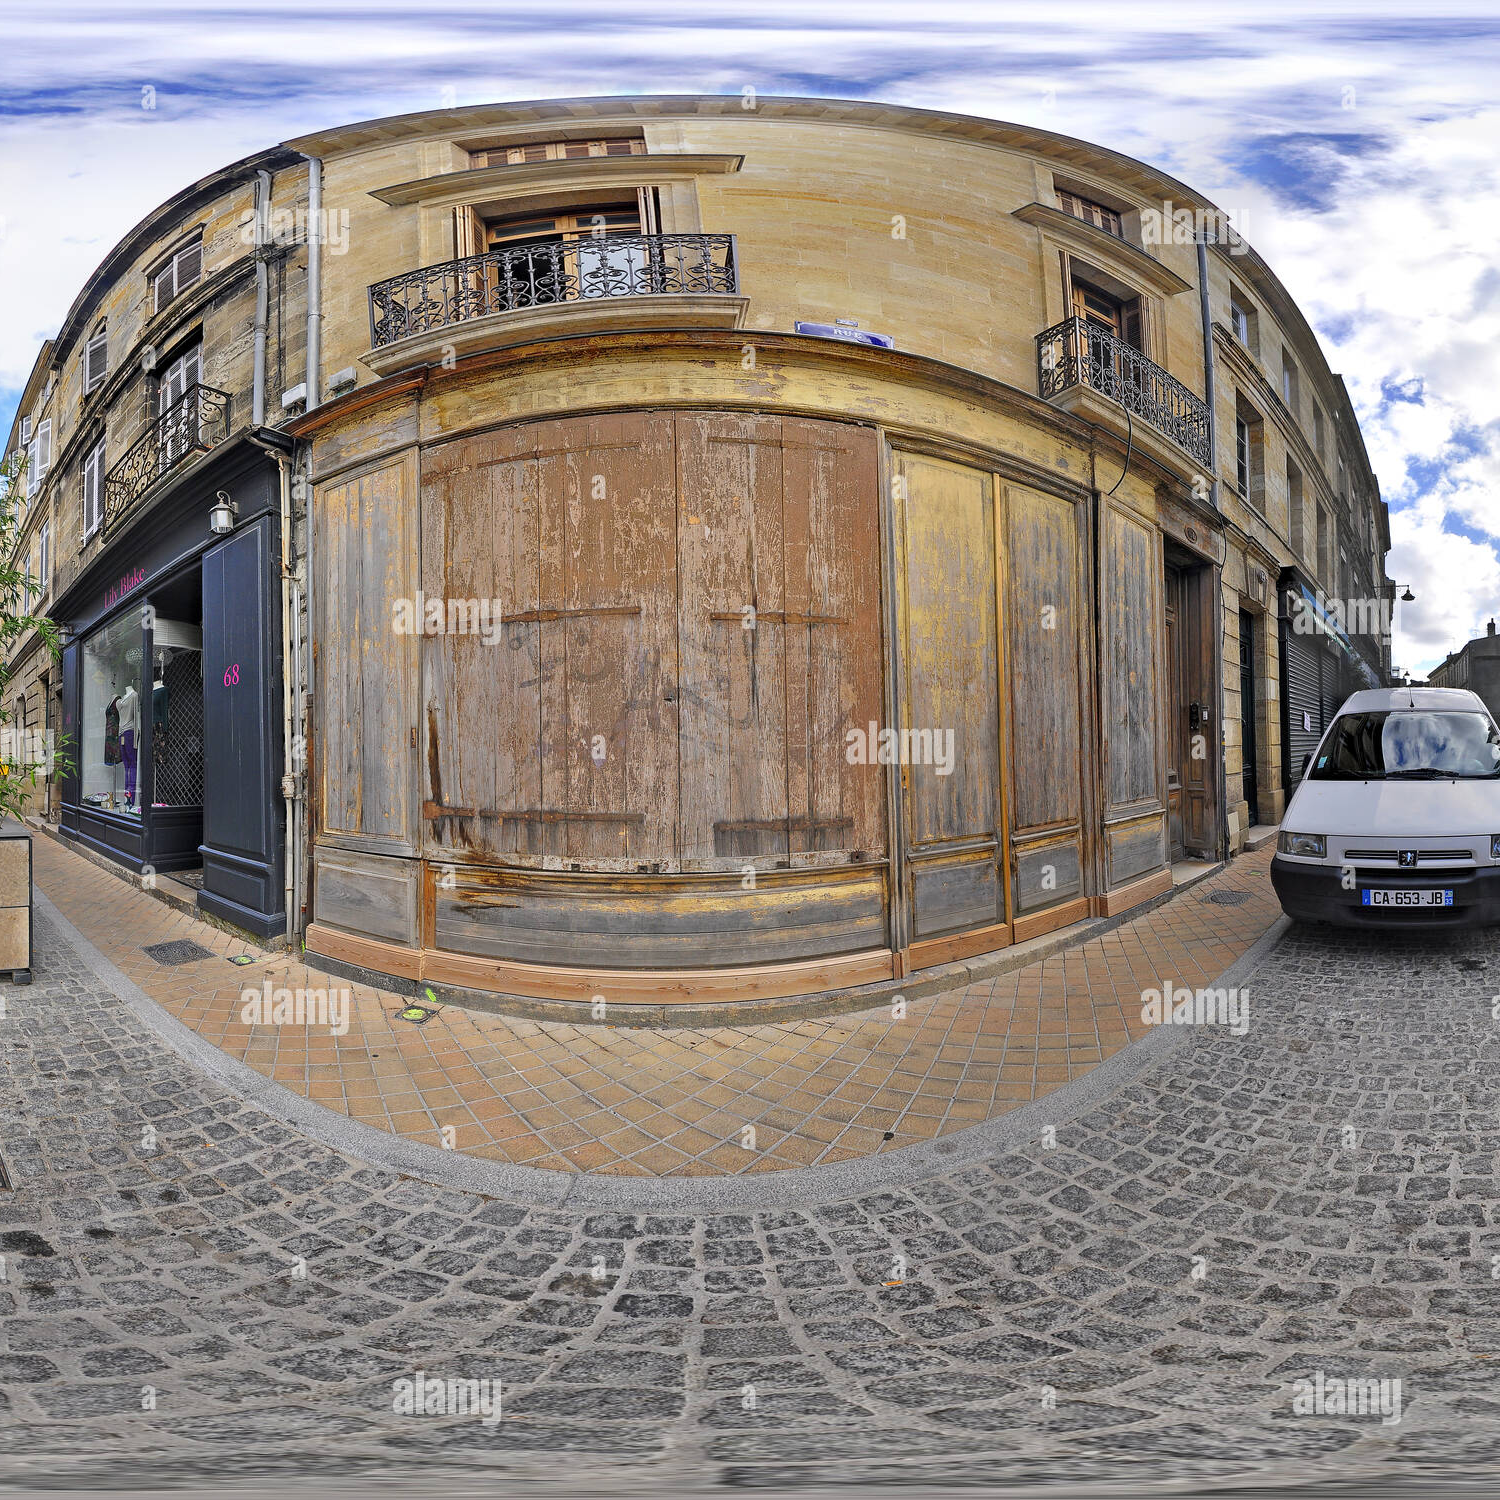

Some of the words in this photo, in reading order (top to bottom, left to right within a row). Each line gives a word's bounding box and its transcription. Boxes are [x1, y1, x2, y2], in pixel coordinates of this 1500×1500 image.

[834, 329, 862, 339] RUE
[104, 585, 118, 609] Lily
[120, 567, 145, 596] Blake
[223, 663, 240, 687] 68
[1373, 891, 1443, 905] CA-653-JB
